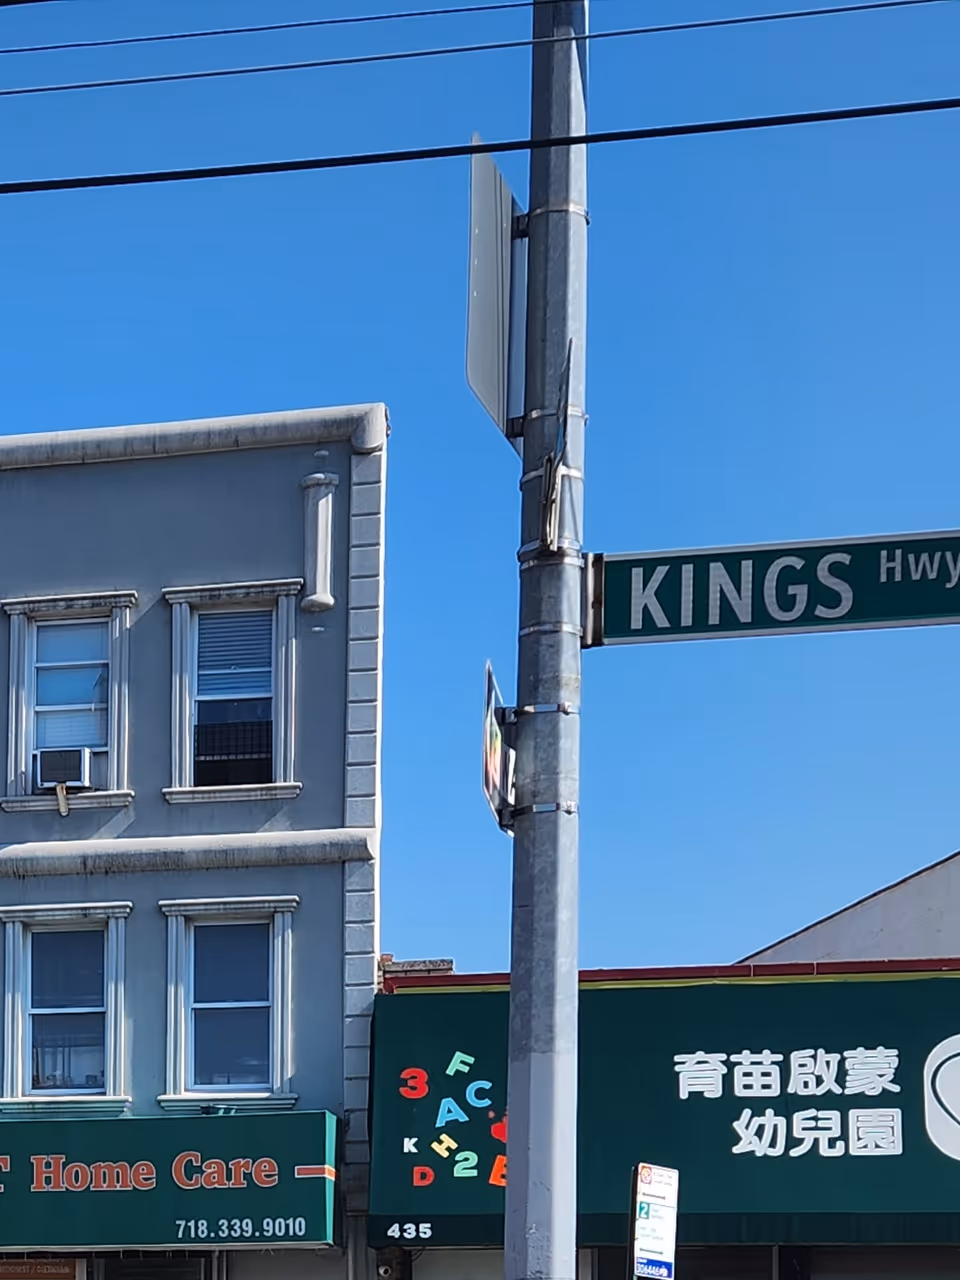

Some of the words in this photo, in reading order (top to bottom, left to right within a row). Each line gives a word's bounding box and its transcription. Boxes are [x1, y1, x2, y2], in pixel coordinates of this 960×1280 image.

[630, 552, 854, 630] KINGS
[880, 548, 960, 589] Hwy
[445, 1051, 475, 1076] F
[399, 1067, 429, 1099] 3
[465, 1080, 492, 1108] C
[435, 1097, 469, 1128] A
[403, 1137, 419, 1153] K
[732, 1108, 903, 1157] 幼兒園
[30, 1154, 157, 1192] Home
[172, 1150, 279, 1190] Care
[413, 1166, 435, 1186] D
[453, 1151, 478, 1177] 2
[175, 1217, 306, 1239] 718.339.9010
[387, 1223, 432, 1239] 435
